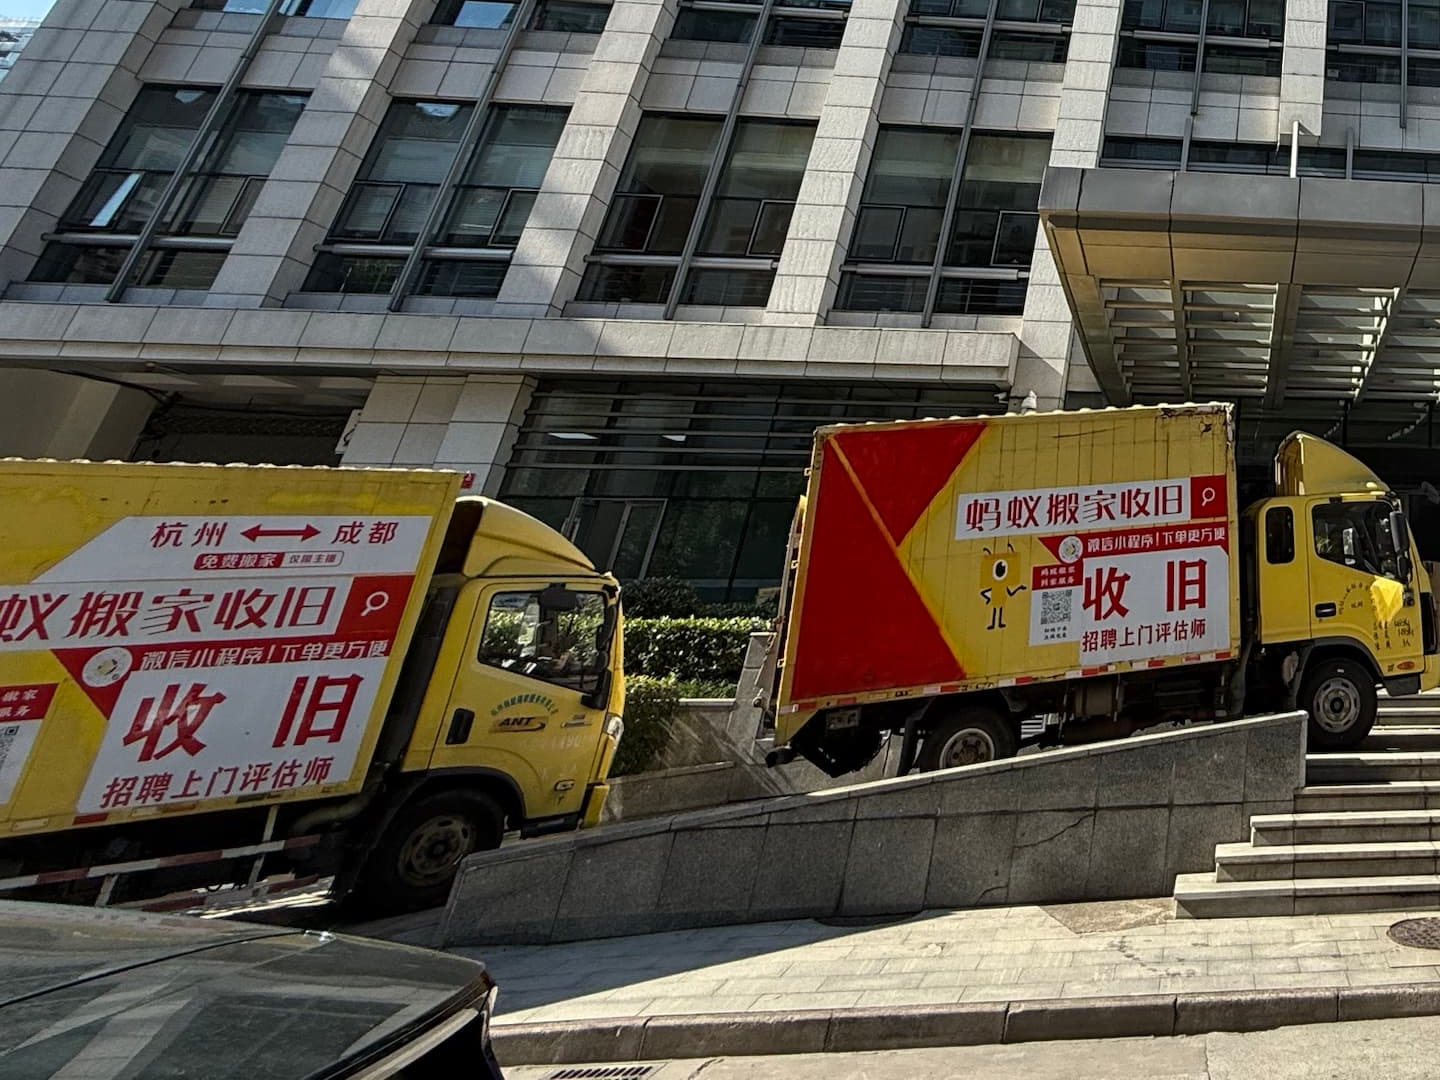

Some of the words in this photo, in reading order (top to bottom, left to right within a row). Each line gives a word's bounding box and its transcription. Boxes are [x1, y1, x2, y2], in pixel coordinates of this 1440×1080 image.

[966, 484, 1183, 532] 蚂蚁搬家收旧
[150, 521, 228, 548] 杭州
[331, 521, 399, 545] 成都
[200, 552, 278, 569] 免费搬家
[0, 584, 337, 643] 蚁搬家收旧
[1082, 618, 1206, 653] 招聘上门评估师
[499, 716, 537, 727] ANT
[101, 756, 335, 809] 招聘上门评估师
